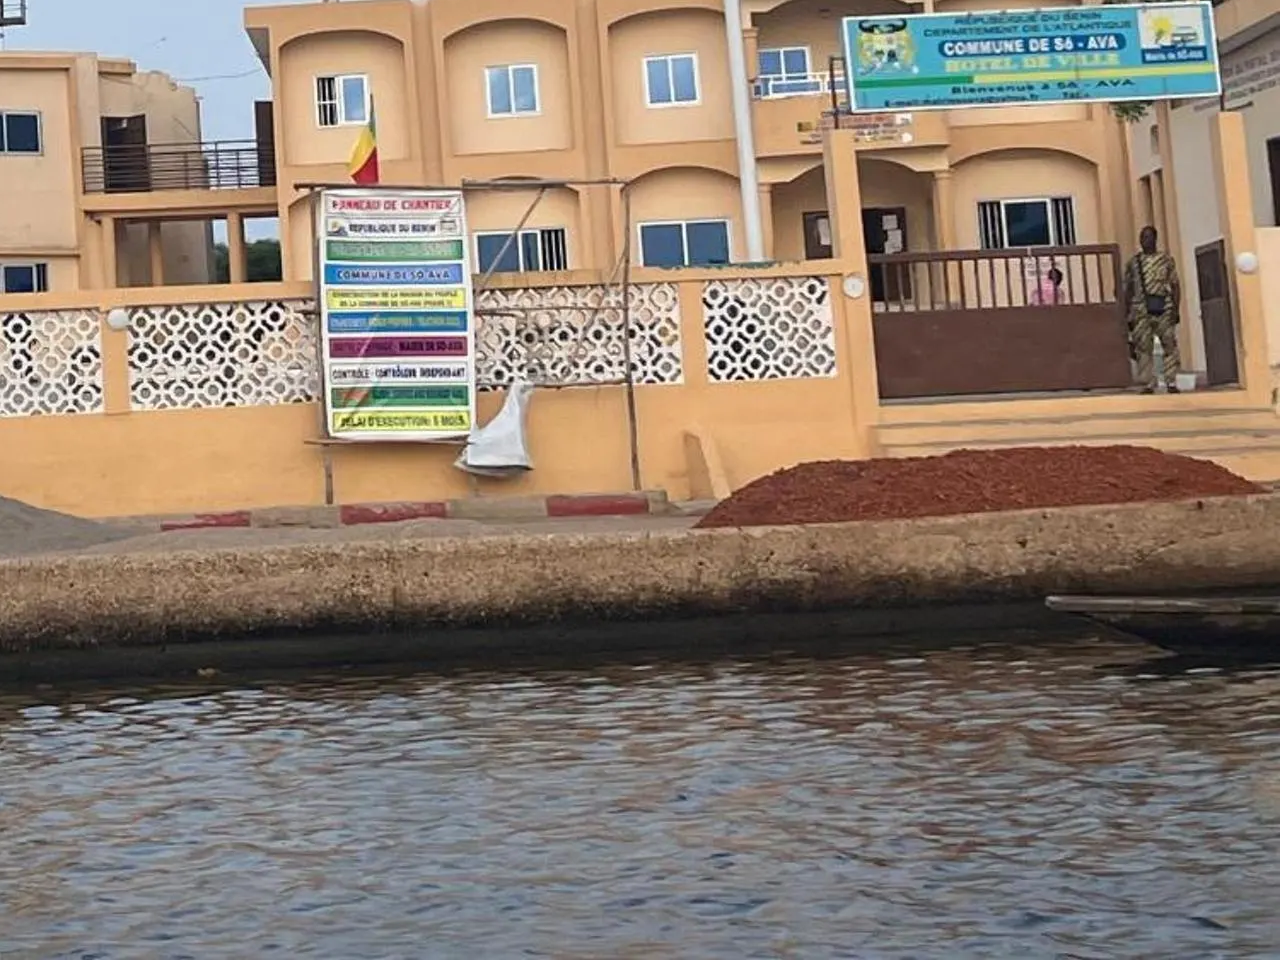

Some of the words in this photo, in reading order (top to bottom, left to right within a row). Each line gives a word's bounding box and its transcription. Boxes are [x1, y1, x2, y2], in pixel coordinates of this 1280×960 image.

[943, 39, 1025, 56] COMMUNE
[1028, 37, 1049, 51] DE
[1087, 34, 1119, 49] AVA
[1023, 55, 1050, 68] DE
[1056, 52, 1120, 67] VILLE
[951, 83, 1035, 94] Bienvenue
[1095, 79, 1136, 88] AVA
[332, 199, 380, 210] PANNEAU
[383, 200, 398, 210] DE
[401, 200, 452, 210] CHANTIER
[399, 224, 409, 232] DU
[337, 269, 391, 280] COMMUNE
[394, 270, 406, 279] DE
